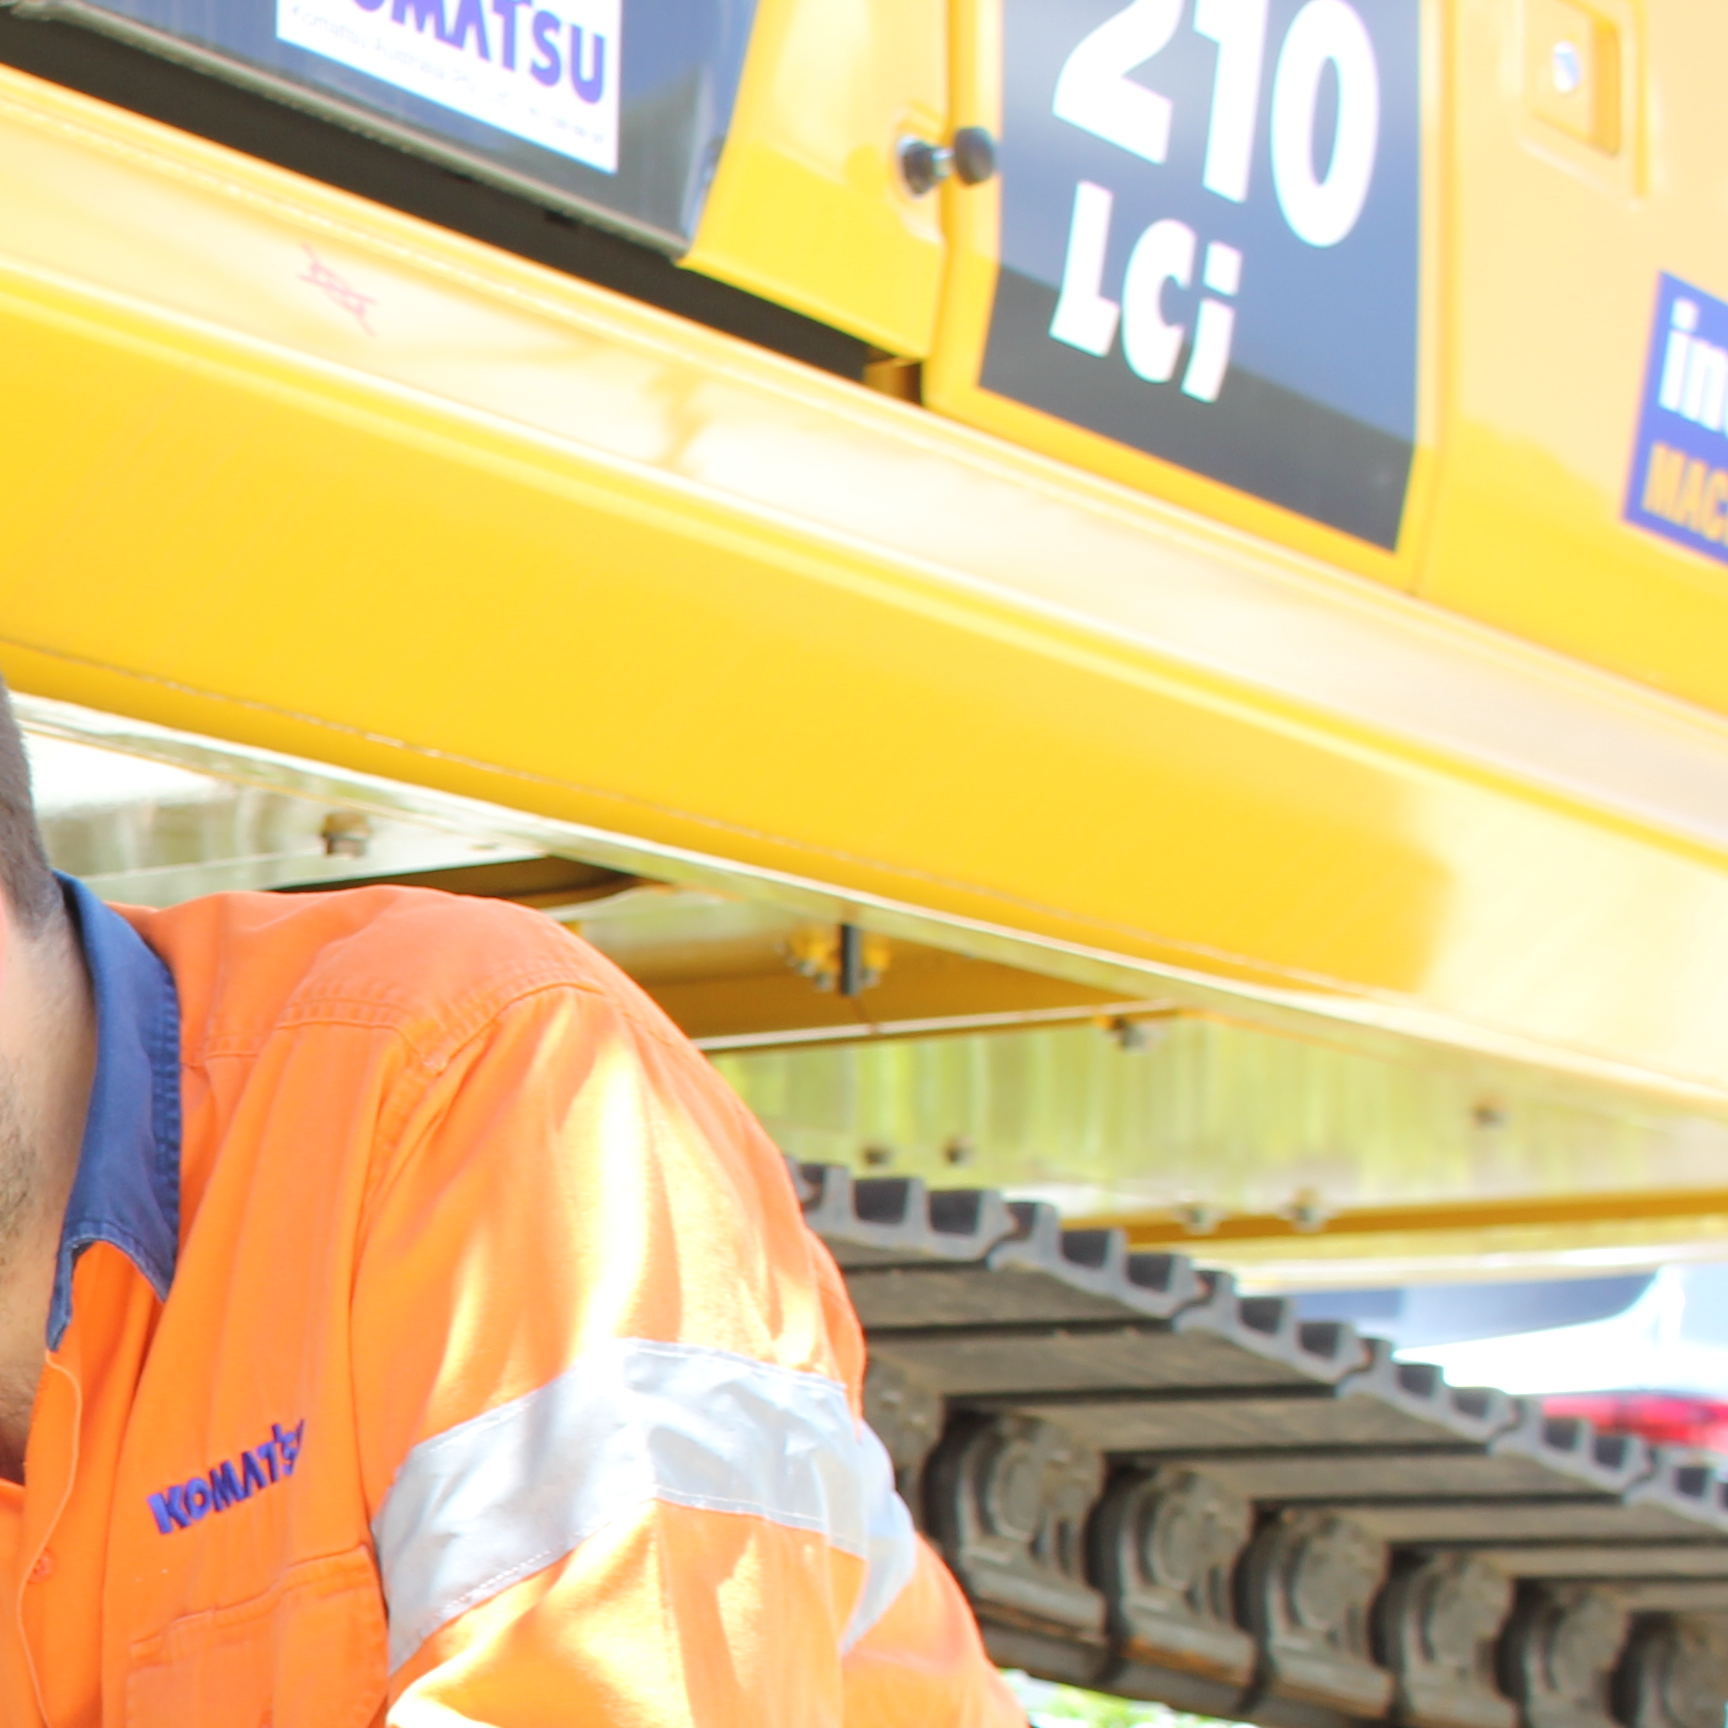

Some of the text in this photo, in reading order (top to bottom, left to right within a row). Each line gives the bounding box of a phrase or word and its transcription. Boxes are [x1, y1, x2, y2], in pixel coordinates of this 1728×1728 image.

[1051, 0, 1381, 248] 210
[1048, 179, 1243, 404] LCi
[1641, 441, 1728, 548] MAC
